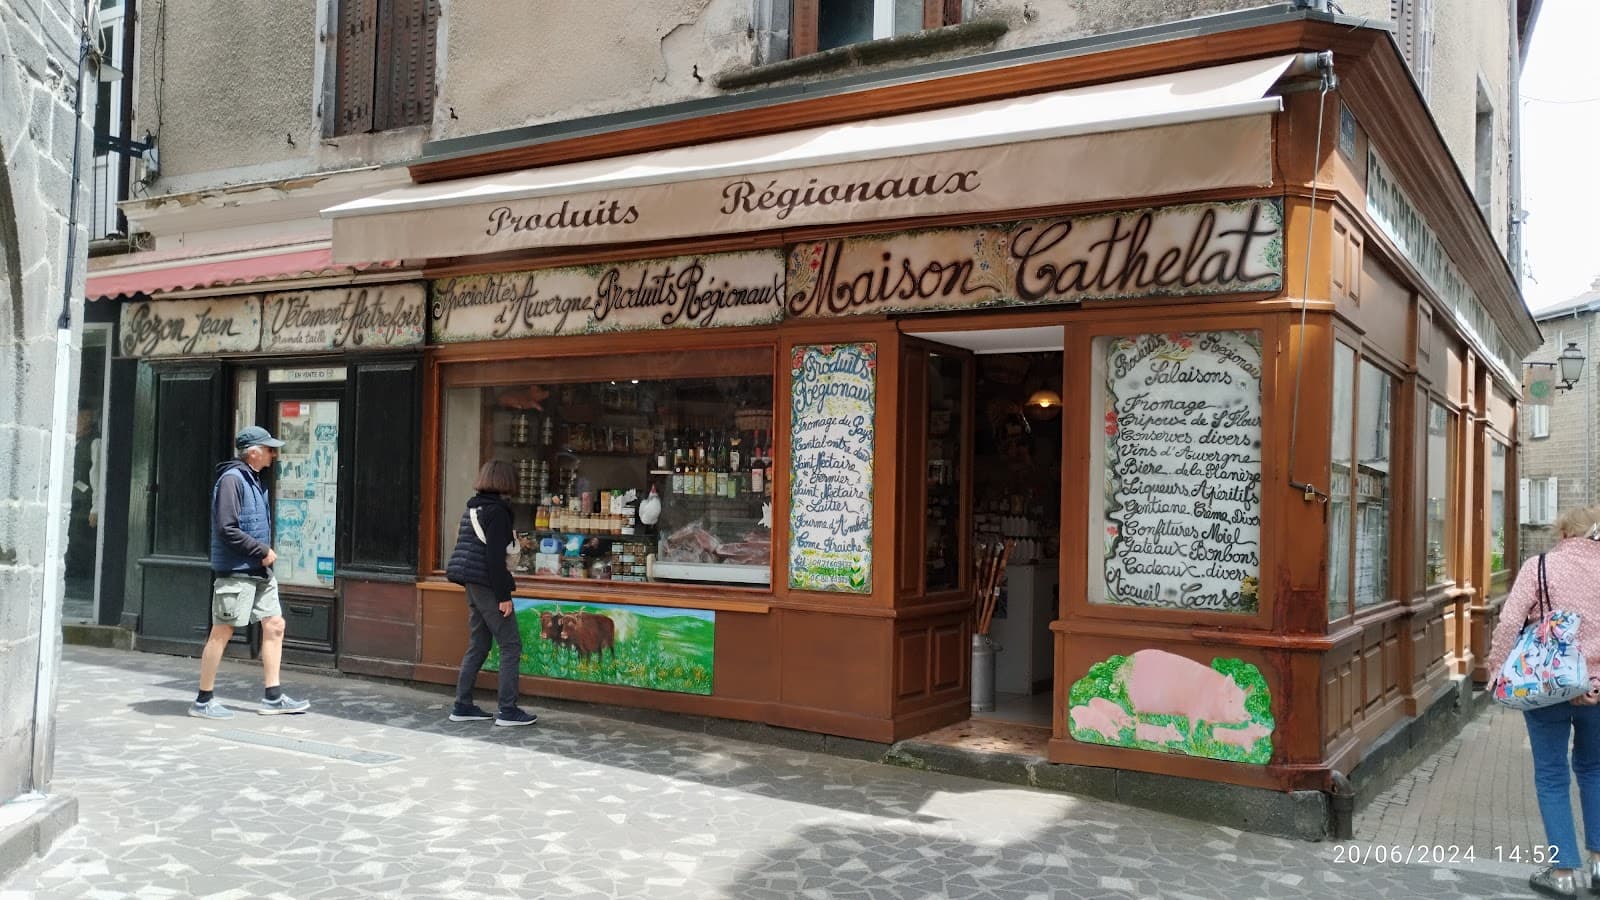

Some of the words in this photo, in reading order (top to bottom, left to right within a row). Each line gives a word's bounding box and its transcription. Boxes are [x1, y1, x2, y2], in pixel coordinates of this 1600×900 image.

[486, 200, 639, 236] Produits
[719, 169, 980, 220] Régionaux
[789, 241, 1000, 316] Maison
[1008, 204, 1279, 303] Cathelat
[433, 277, 518, 330] Spécialités
[592, 267, 677, 322] Produits
[661, 259, 785, 327] Régionaux
[182, 307, 240, 354] Jean
[806, 351, 869, 382] Produits
[1115, 334, 1166, 379] Produits
[1145, 361, 1232, 386] Salaisons
[1122, 393, 1213, 415] Fromage
[793, 415, 836, 434] Fromage
[839, 415, 851, 427] du
[848, 416, 873, 443] Pays
[1190, 412, 1208, 426] de
[1121, 428, 1192, 443] Conserves
[1199, 429, 1251, 446] divers
[1121, 444, 1156, 457] Vins
[1121, 476, 1188, 501] Liqueurs
[1191, 479, 1259, 511] Apéritifs
[1124, 496, 1189, 519] Gentiane
[1124, 519, 1199, 544] Confitures
[1201, 523, 1256, 545] Miel
[1123, 557, 1199, 578] Cadeaux
[1189, 540, 1258, 567] Bonbons
[1107, 568, 1166, 602] Accueil
[1180, 584, 1242, 607] Conse
